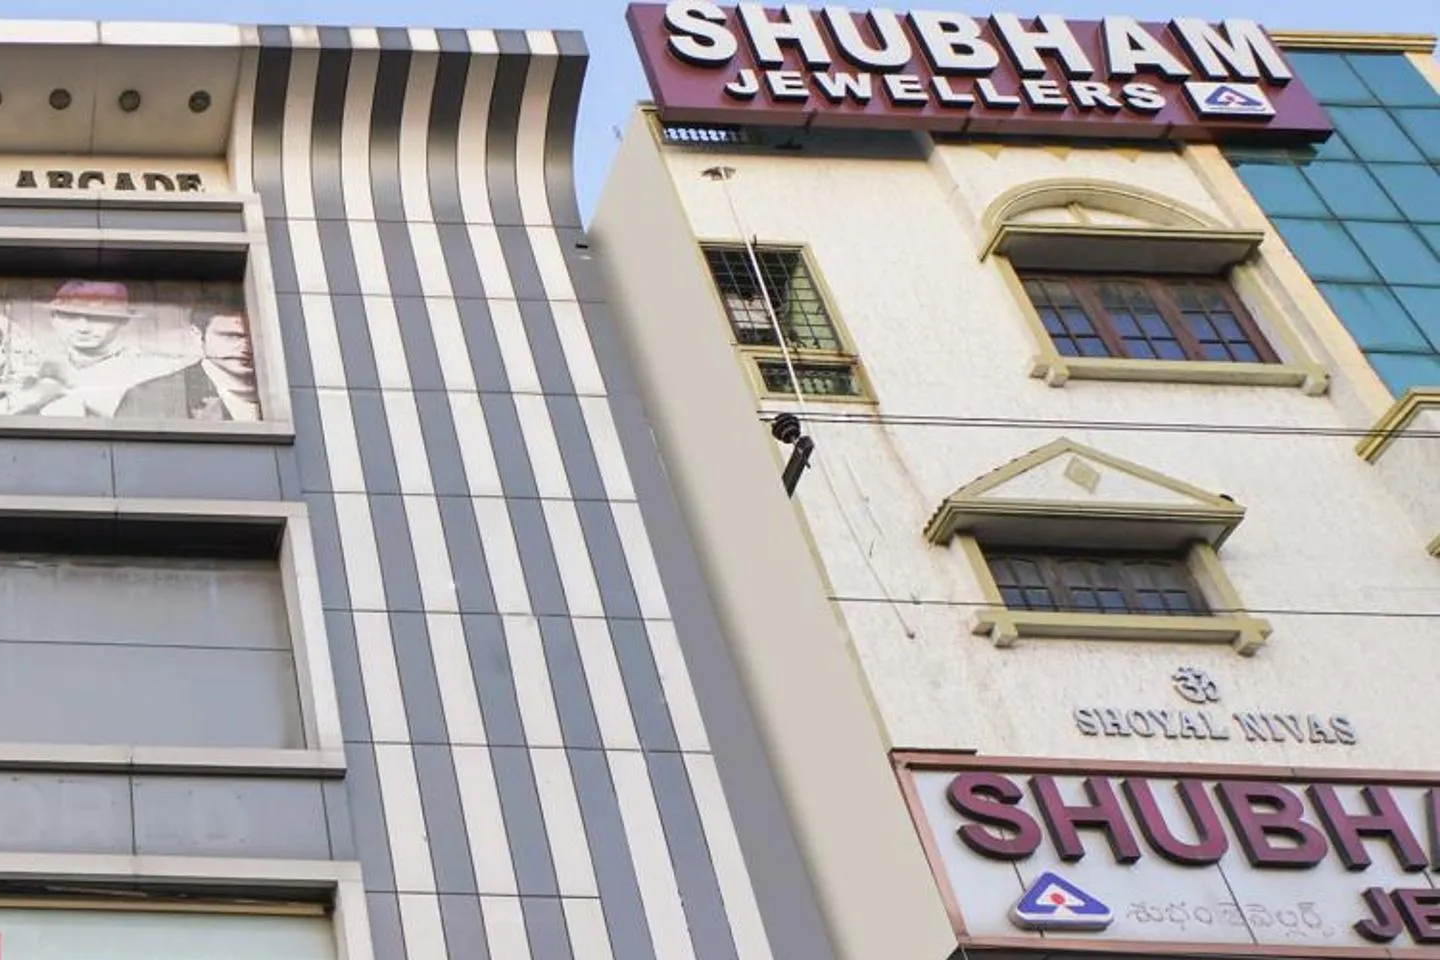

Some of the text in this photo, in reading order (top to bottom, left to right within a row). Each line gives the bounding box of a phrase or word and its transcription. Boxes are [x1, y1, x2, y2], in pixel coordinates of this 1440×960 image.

[666, 1, 1292, 84] SHUBHAM
[725, 70, 1166, 112] JEWELLERS
[1074, 708, 1356, 746] SHOYAL NIVAS
[946, 771, 1440, 872] SHUBH
[1353, 886, 1440, 943] JE
